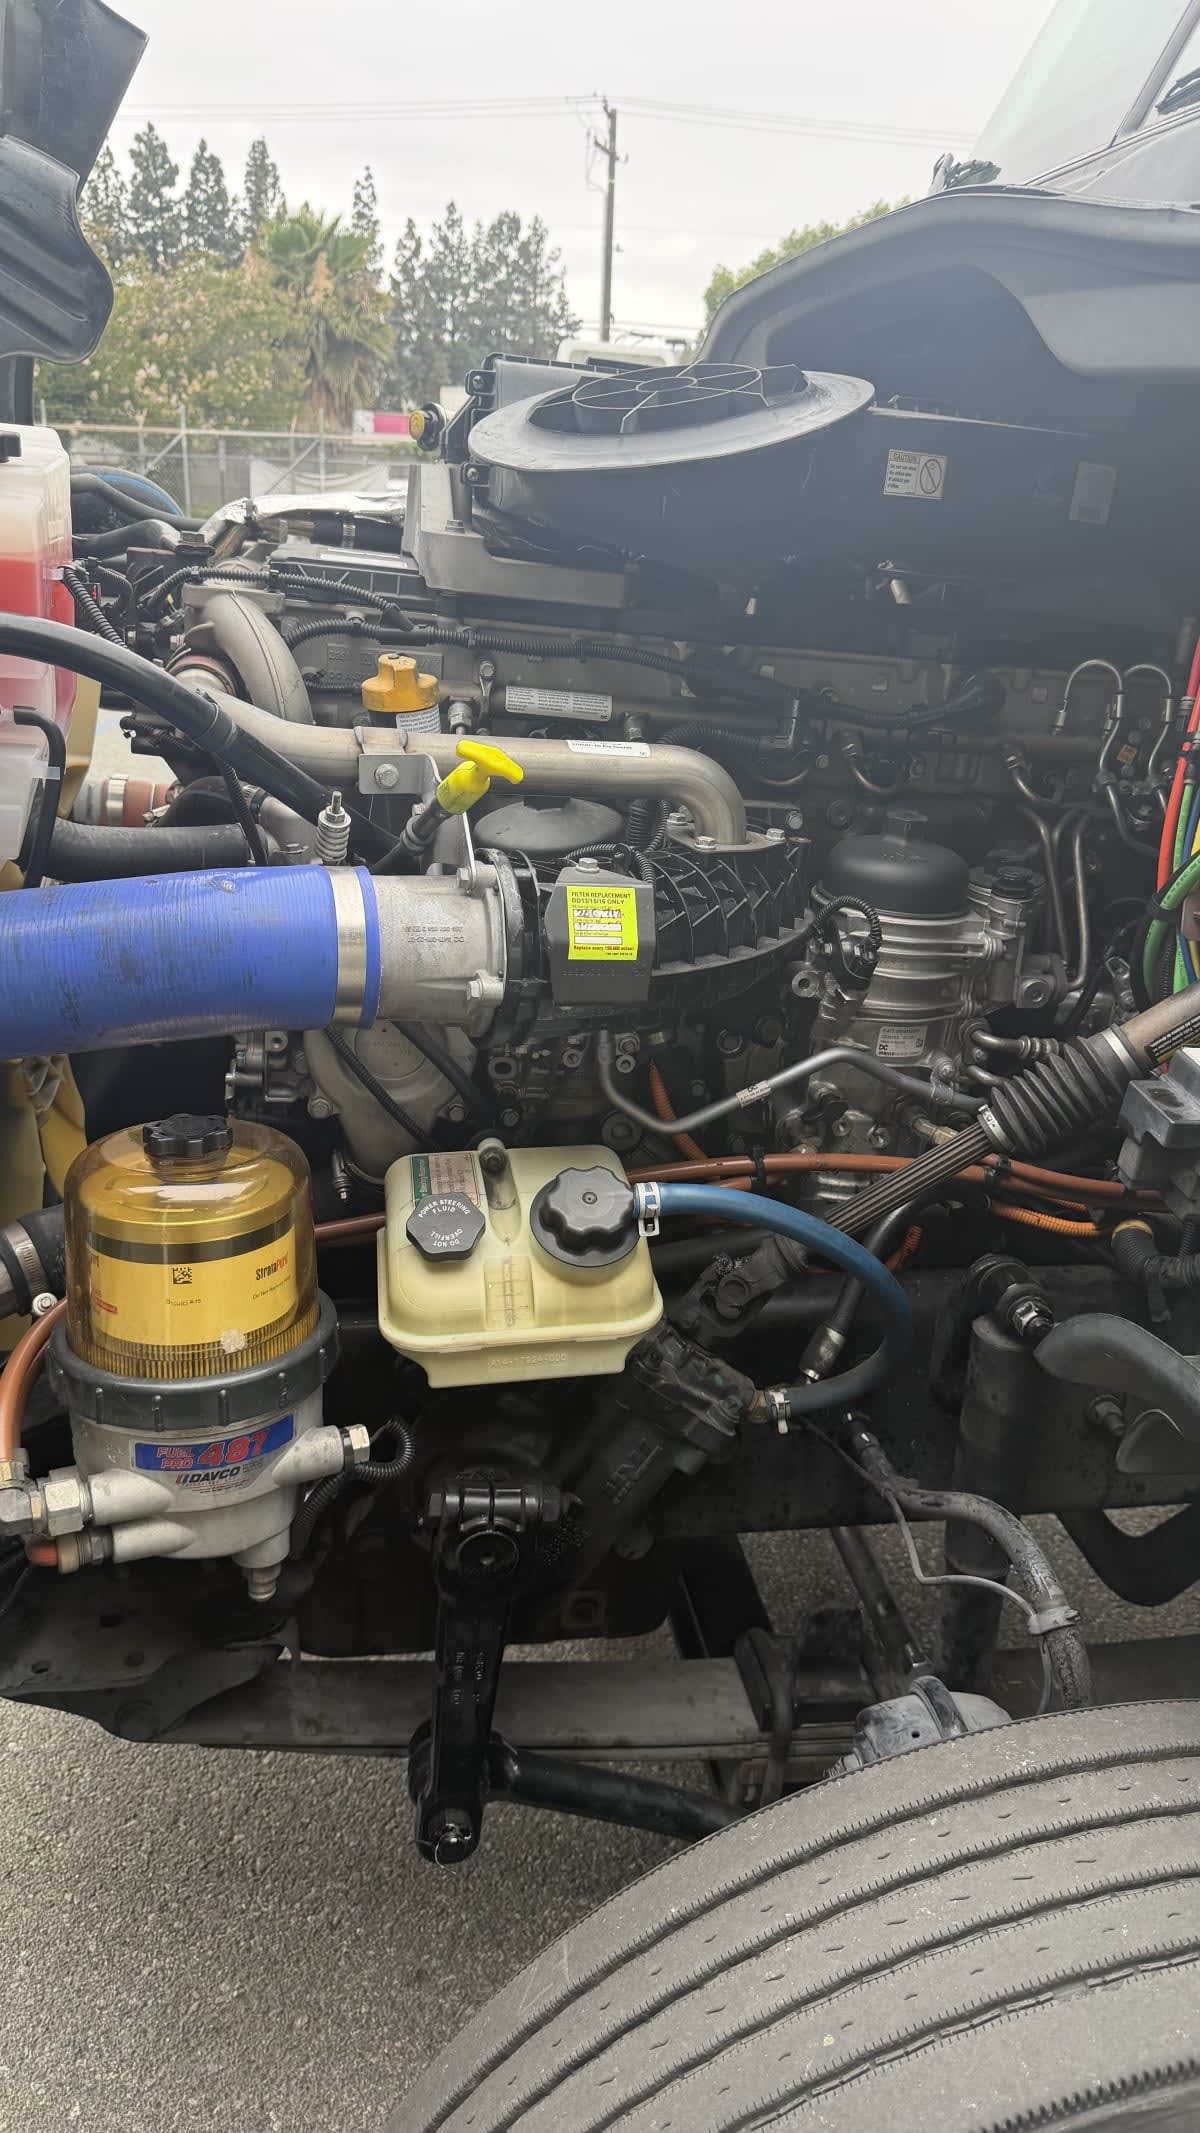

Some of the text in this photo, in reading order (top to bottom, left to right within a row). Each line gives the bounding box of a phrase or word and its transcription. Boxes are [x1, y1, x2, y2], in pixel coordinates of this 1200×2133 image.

[418, 1199, 471, 1218] POWER STEERING
[431, 1205, 456, 1215] FLUID
[430, 1228, 463, 1241] OVERFILL
[432, 1238, 460, 1248] DO NOT
[156, 1446, 194, 1459] FUEL
[197, 1428, 270, 1467] 487
[160, 1457, 194, 1470] PRO
[188, 1465, 241, 1484] DAVCO
